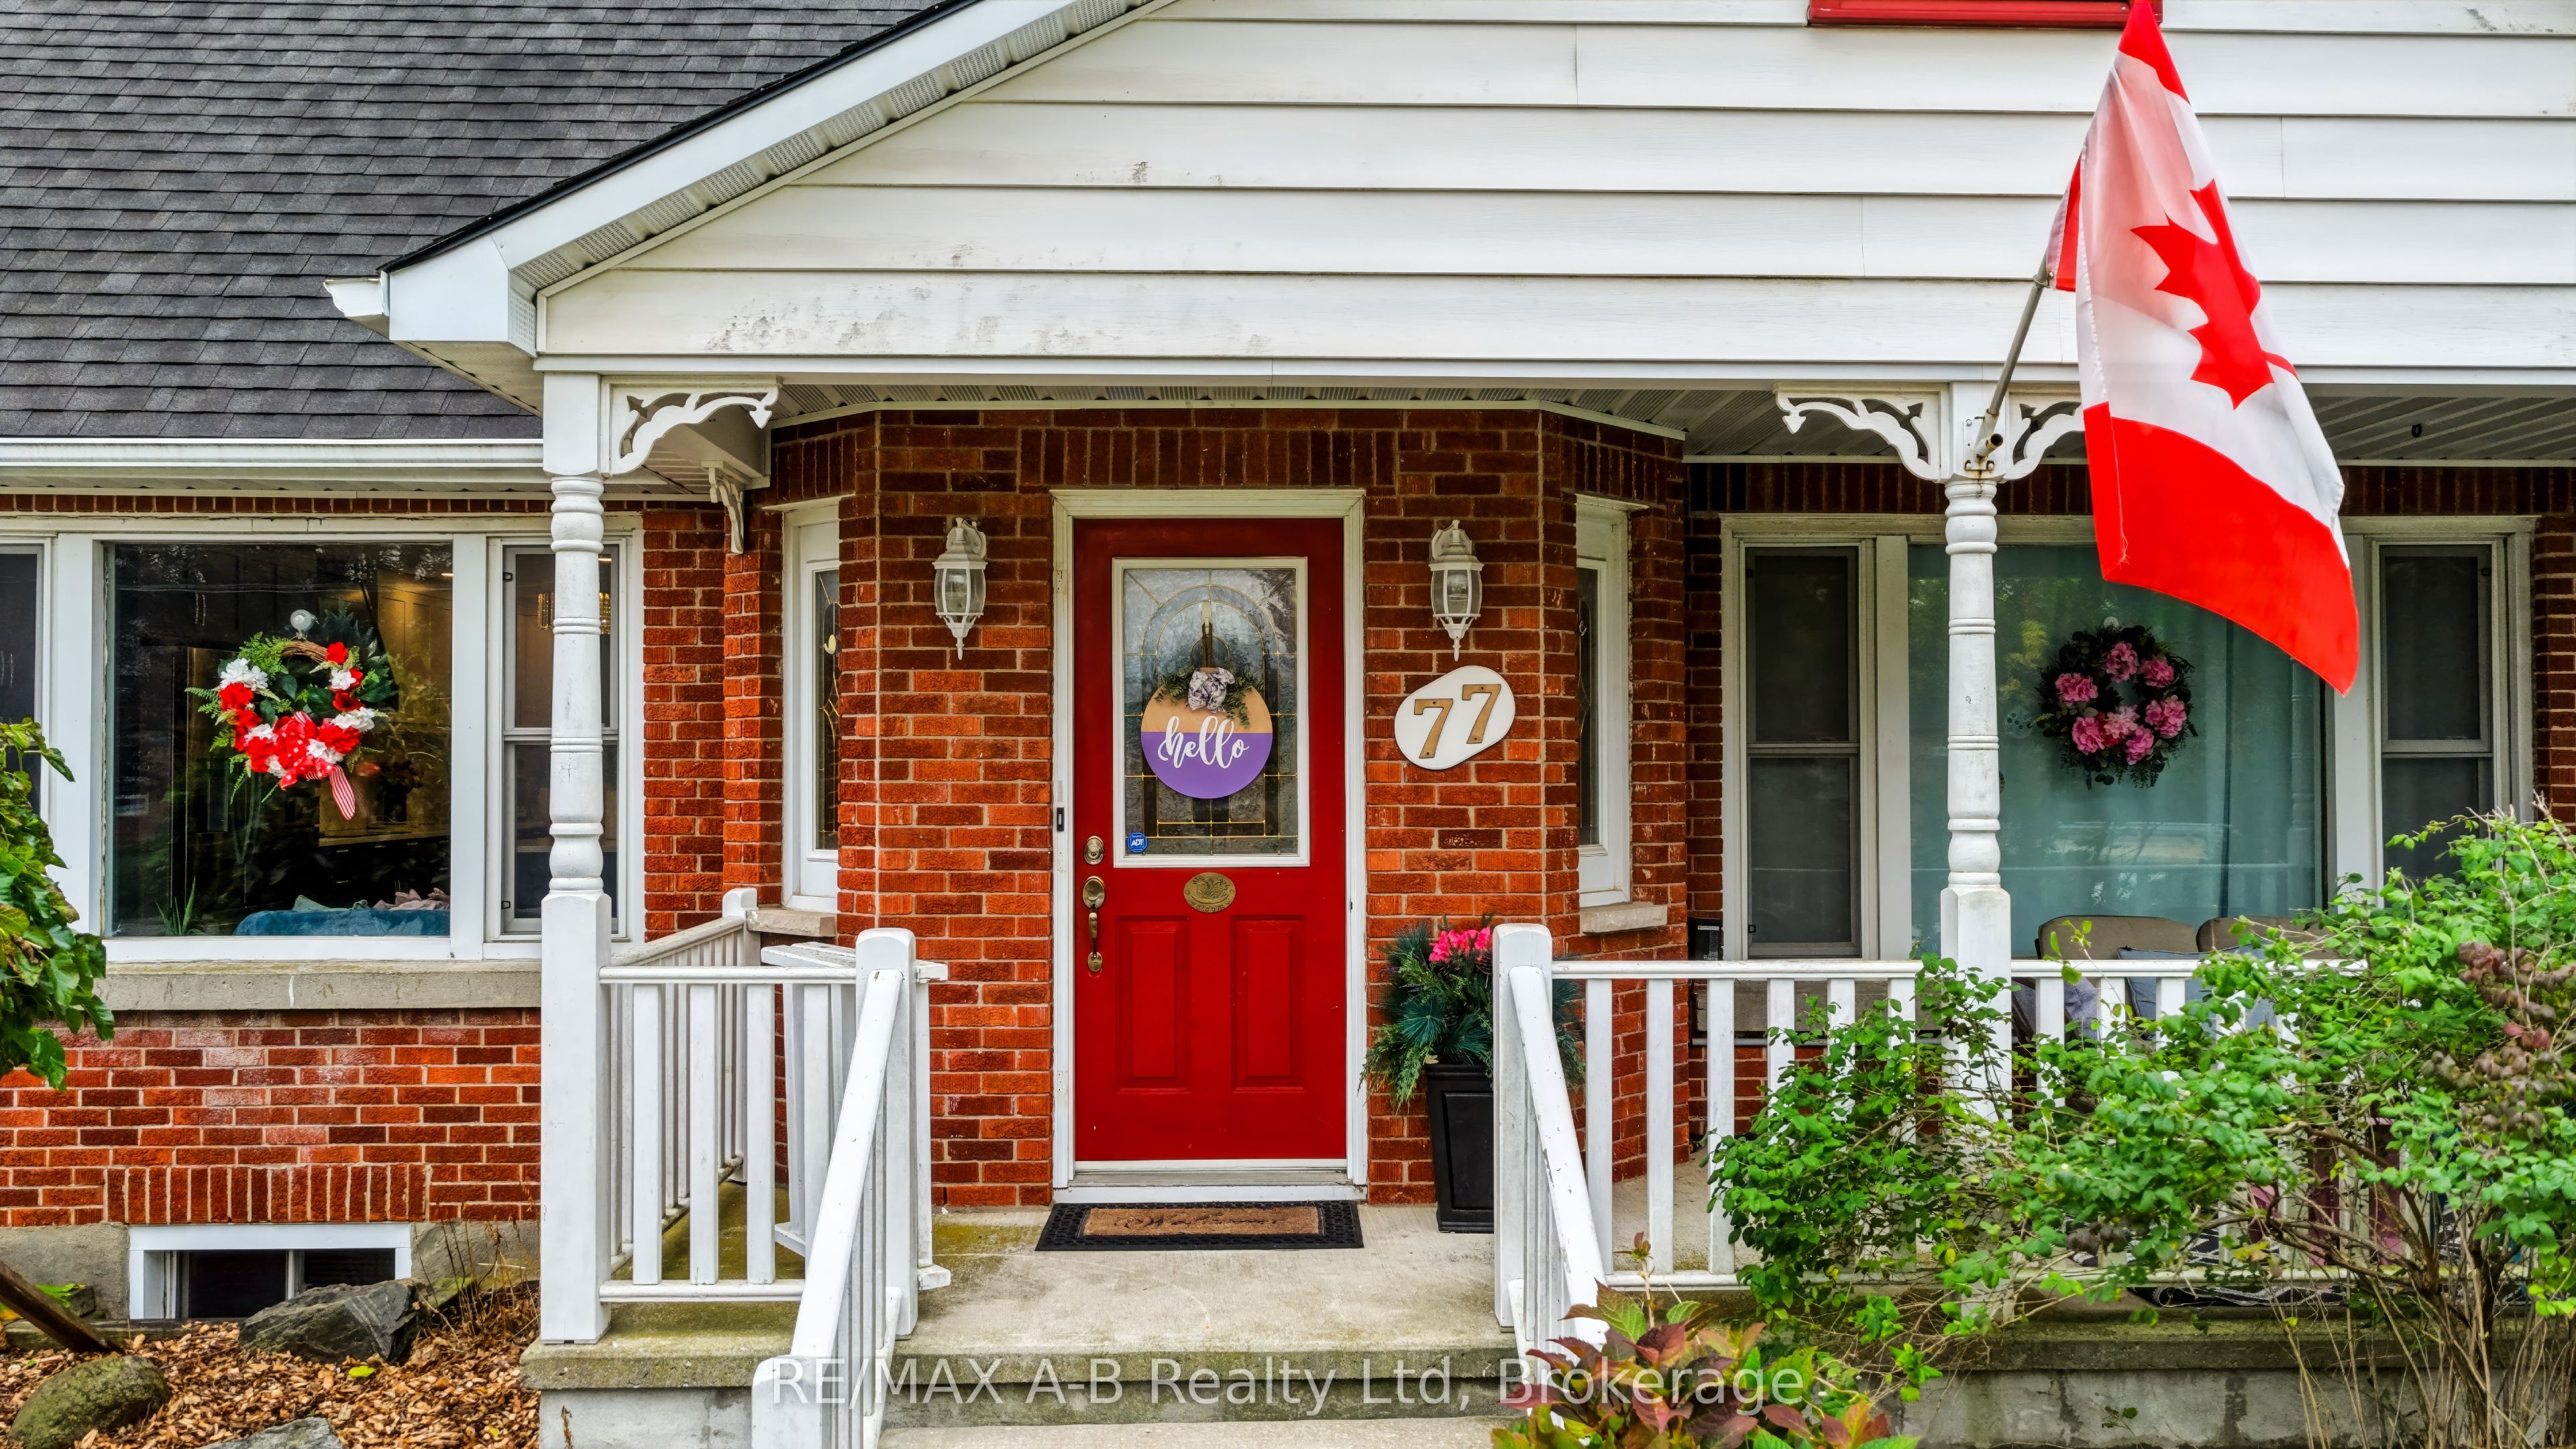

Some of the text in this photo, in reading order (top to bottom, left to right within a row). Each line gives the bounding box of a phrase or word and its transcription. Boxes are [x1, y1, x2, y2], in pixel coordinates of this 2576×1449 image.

[1158, 715, 1250, 769] hello
[1413, 684, 1501, 759] 77
[1130, 839, 1144, 847] ADT
